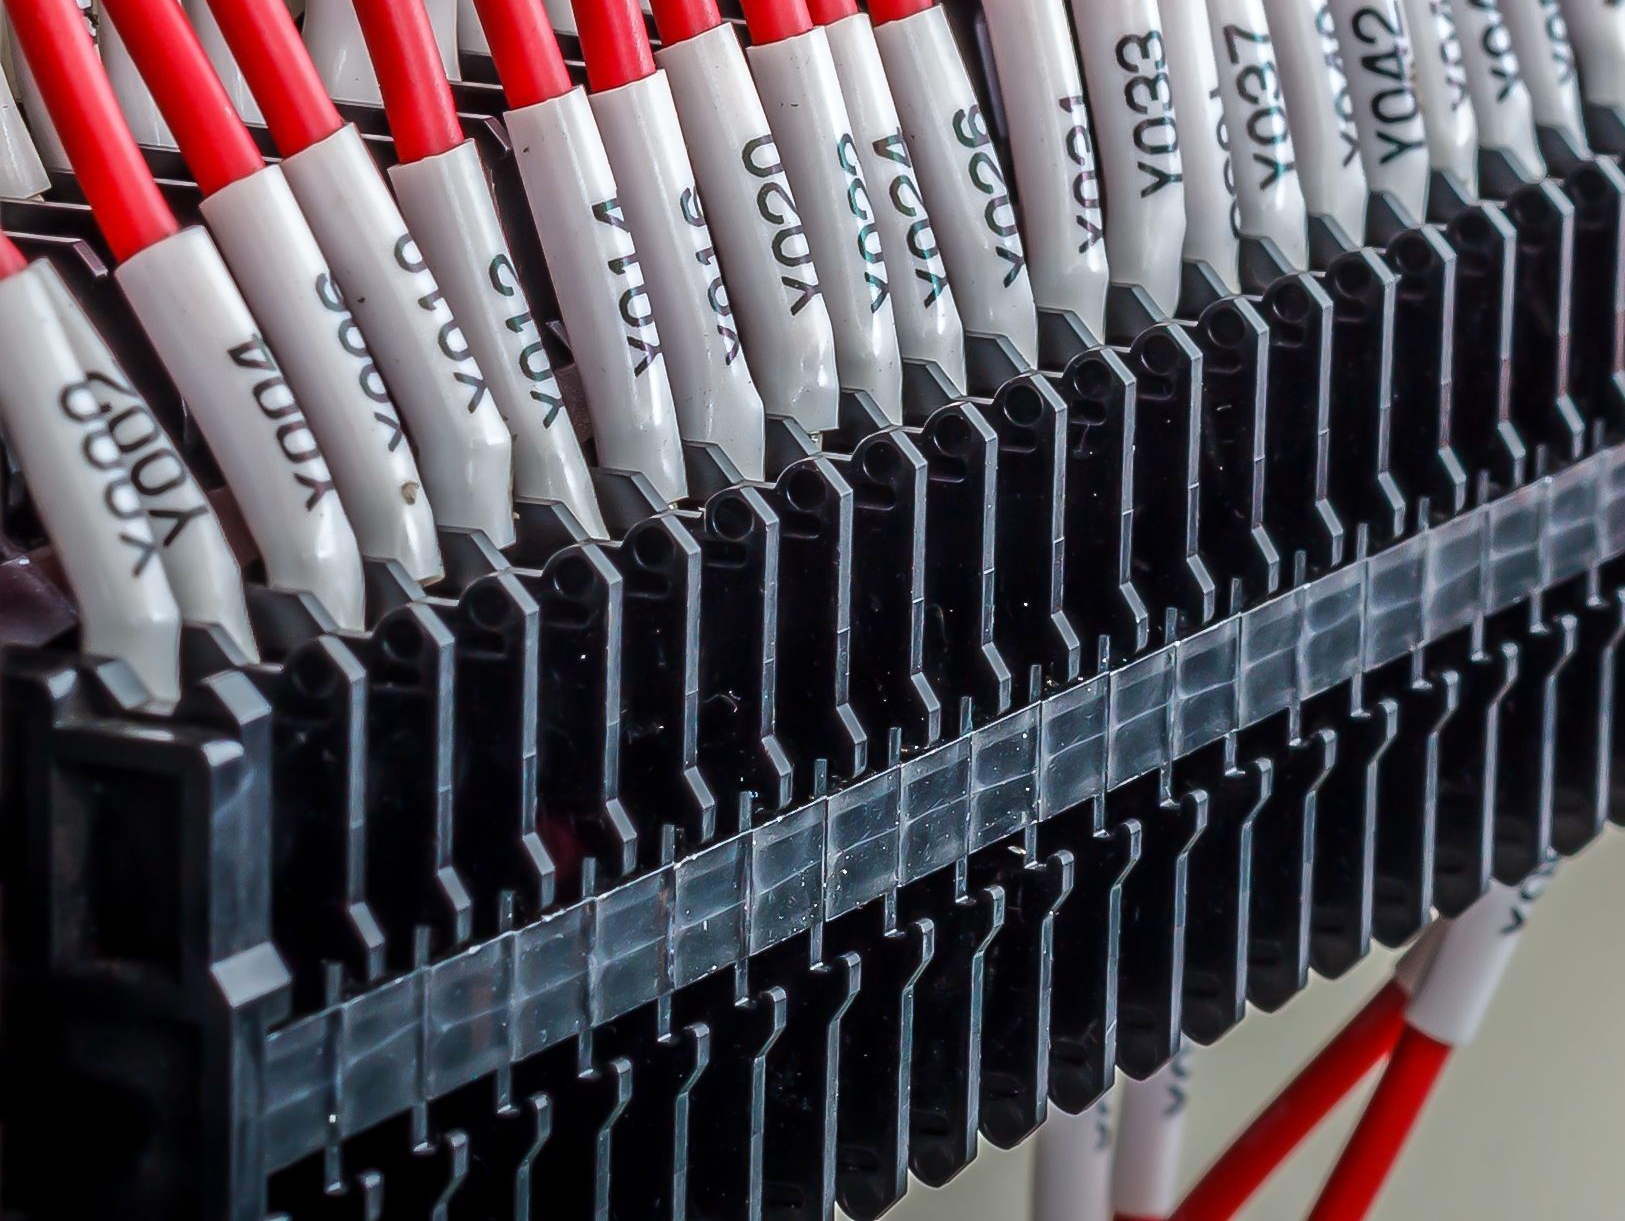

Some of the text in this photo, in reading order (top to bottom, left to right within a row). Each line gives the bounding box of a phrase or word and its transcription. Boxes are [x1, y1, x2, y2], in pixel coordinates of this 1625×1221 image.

[951, 104, 1026, 288] Y026
[1115, 29, 1183, 198] Y033
[1223, 23, 1297, 191] Y037
[591, 196, 664, 377] Y014
[741, 133, 822, 316] Y020
[872, 126, 947, 308] Y024
[226, 332, 334, 511] Y004
[488, 253, 564, 429] Y012
[84, 371, 206, 547] Y002
